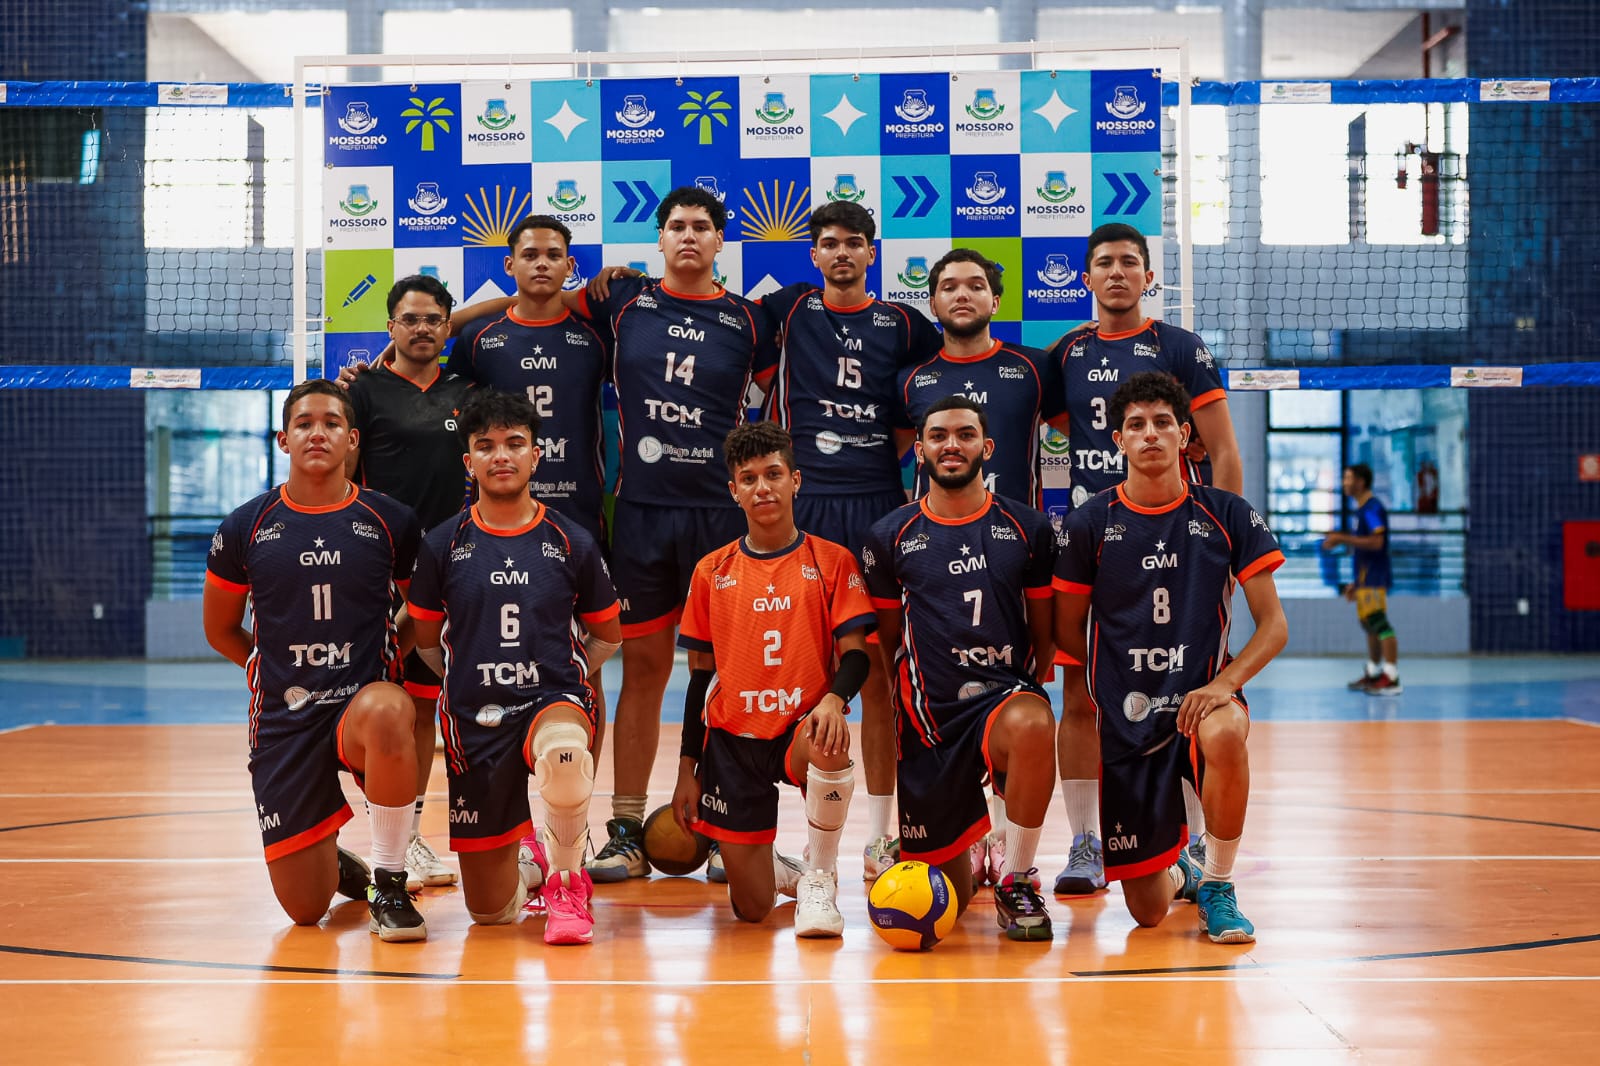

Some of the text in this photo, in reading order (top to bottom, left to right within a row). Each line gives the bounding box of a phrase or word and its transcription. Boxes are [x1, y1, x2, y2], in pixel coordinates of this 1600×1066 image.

[746, 125, 804, 135] MOSSORÓ
[885, 122, 944, 133] MOSSORÓ
[956, 121, 1014, 132] MOSSORÓ
[1096, 119, 1155, 131] MOSSORÓ
[329, 135, 387, 145] MOSSORÓ
[468, 131, 525, 142] MOSSORÓ
[606, 128, 664, 139] MOSSORÓ
[956, 204, 1015, 215] MOSSORÓ
[1027, 204, 1085, 214] MOSSORÓ
[329, 217, 387, 228] MOSSORÓ
[399, 215, 457, 226] MOSSORÓ
[888, 291, 929, 299] MOSSO
[1028, 287, 1087, 298] MOSSORÓ
[668, 325, 705, 342] GVM
[521, 357, 557, 370] GVM
[665, 352, 695, 386] 14
[836, 357, 862, 389] 15
[1088, 369, 1119, 381] GVM
[526, 385, 553, 417] 12
[644, 399, 704, 426] TCM
[818, 400, 879, 420] TCM
[1091, 397, 1106, 430] 3
[1040, 457, 1069, 465] OSSO
[1075, 449, 1123, 470] TCM
[300, 551, 341, 565] GVM
[948, 555, 987, 575] GVM
[1142, 553, 1178, 569] GVM
[490, 571, 529, 585] GVM
[311, 583, 332, 620] 11
[753, 596, 791, 612] GVM
[963, 589, 983, 627] 7
[1153, 587, 1170, 624] 8
[500, 603, 520, 640] 6
[289, 642, 354, 667] TCM
[763, 630, 782, 666] 2
[952, 645, 1013, 667] TCM
[1128, 644, 1190, 671] TCM
[477, 661, 541, 686] TCM
[739, 687, 806, 713] TCM
[701, 793, 728, 815] GVM
[902, 825, 927, 839] GVM
[1108, 834, 1138, 851] GVM
